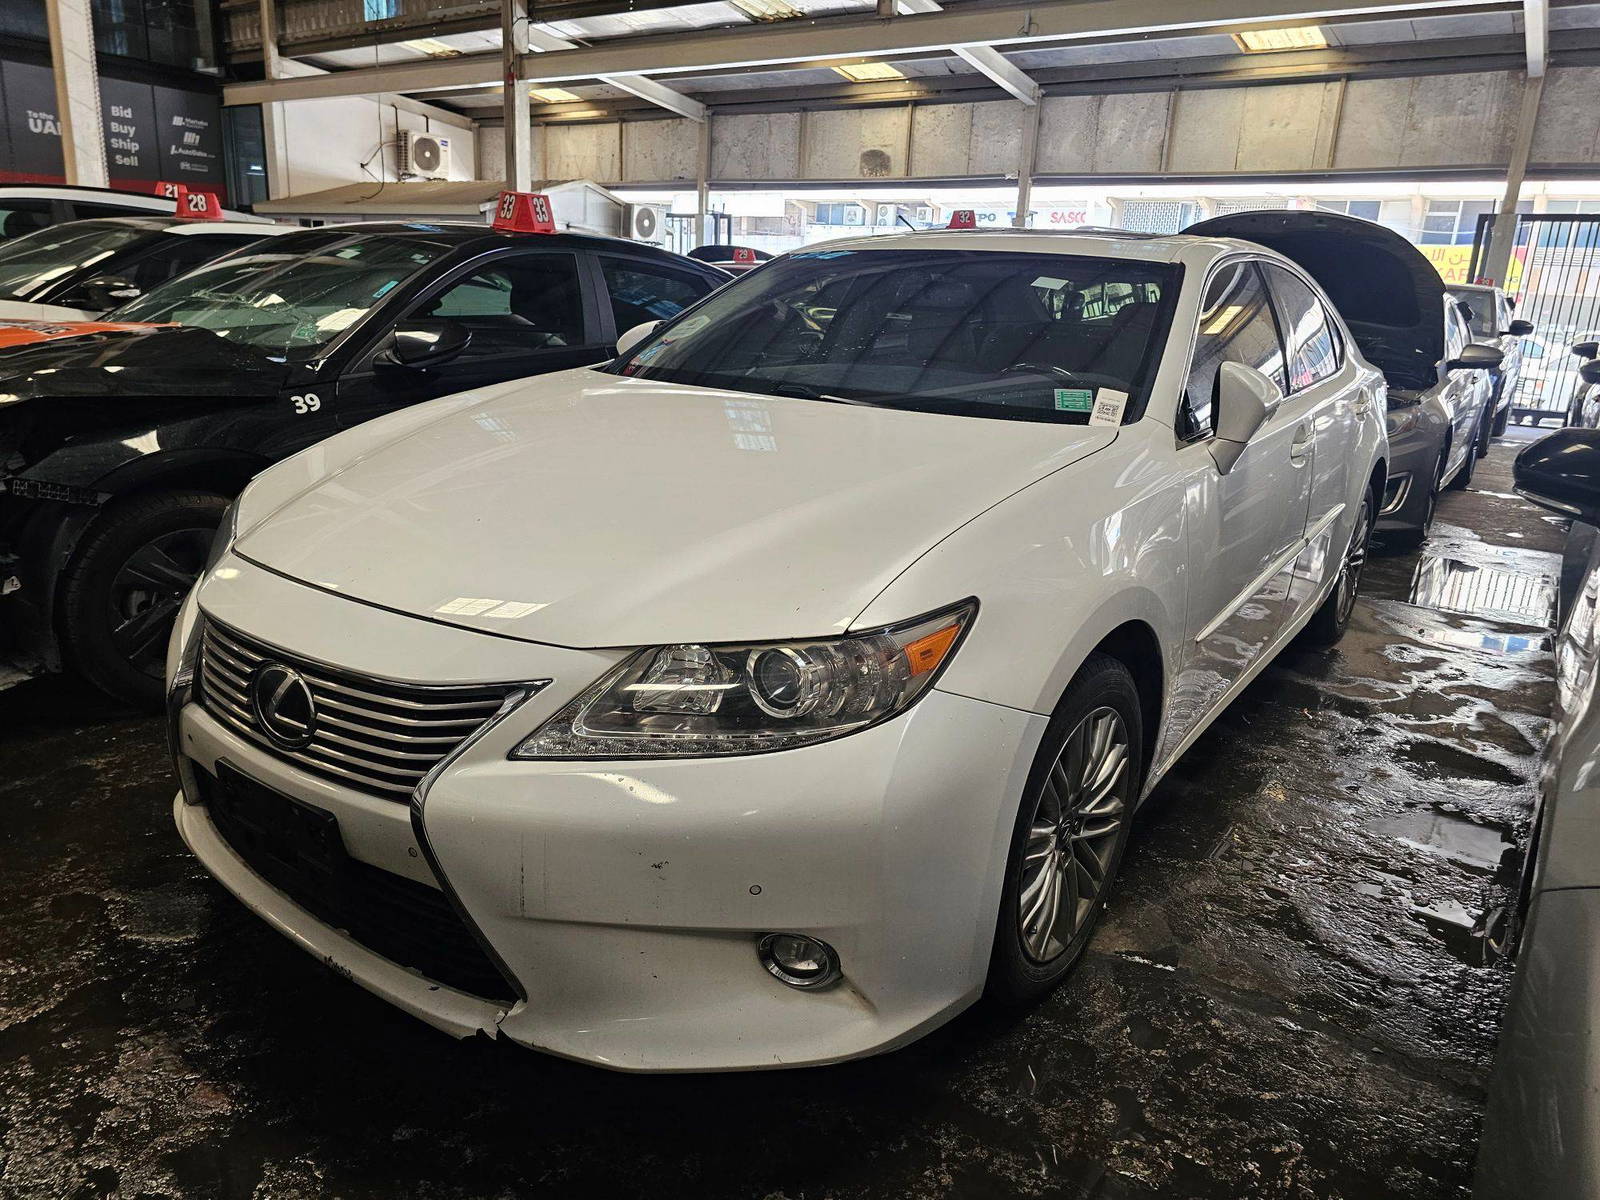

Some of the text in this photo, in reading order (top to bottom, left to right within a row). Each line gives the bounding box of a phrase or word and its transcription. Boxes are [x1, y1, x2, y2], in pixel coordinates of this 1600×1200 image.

[27, 110, 38, 118] To
[111, 105, 132, 118] Bid
[111, 122, 136, 137] Buy
[110, 138, 139, 154] Ship
[115, 154, 139, 166] Sell
[165, 184, 178, 198] 21
[188, 194, 207, 212] 28
[501, 194, 516, 219] 33
[533, 197, 549, 222] 33
[959, 210, 970, 223] 32
[290, 393, 321, 414] 39
